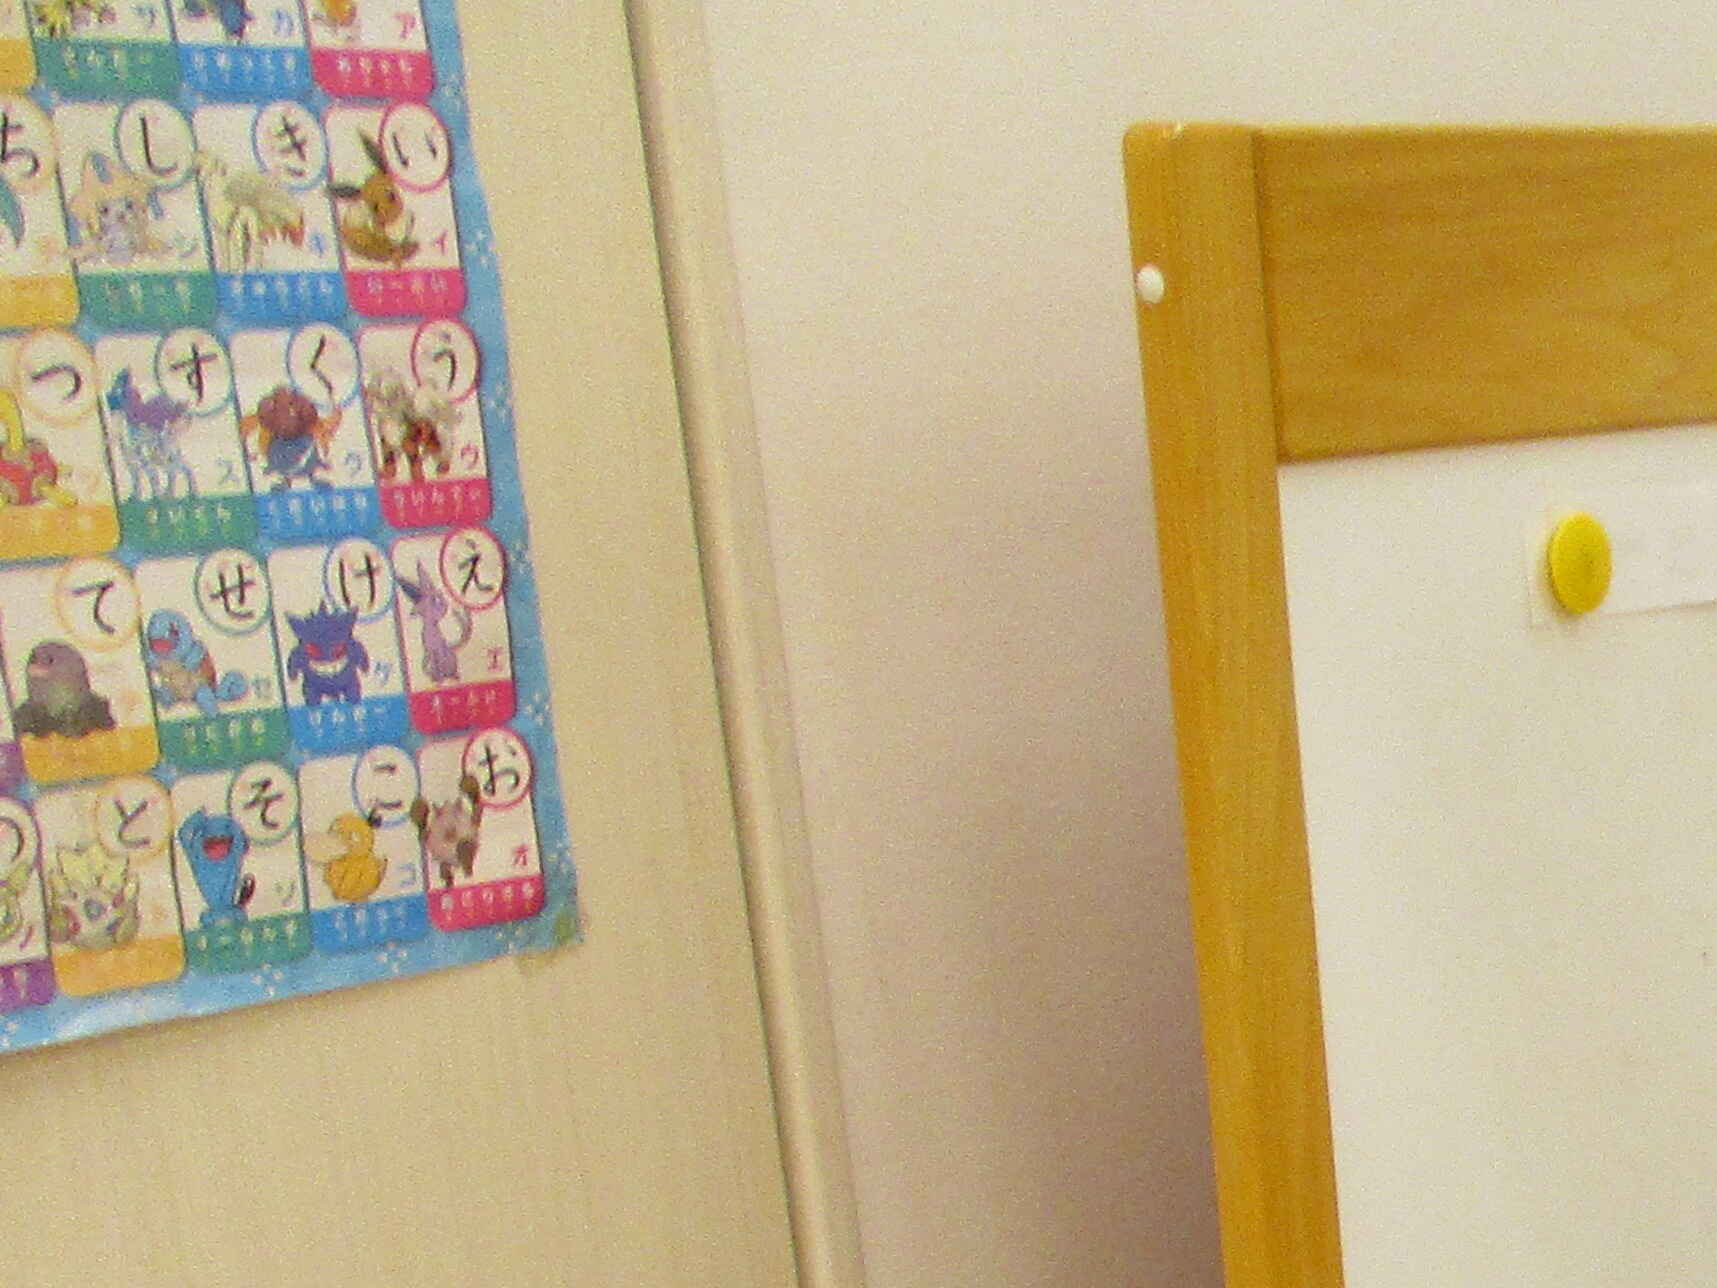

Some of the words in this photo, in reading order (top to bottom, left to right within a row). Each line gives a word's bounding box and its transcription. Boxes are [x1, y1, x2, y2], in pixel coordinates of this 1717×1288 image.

[139, 116, 178, 176] し
[272, 114, 308, 178] き
[391, 131, 437, 169] い
[31, 363, 83, 401] つ
[169, 342, 219, 403] す
[310, 335, 334, 398] く
[432, 332, 458, 393] う
[208, 563, 258, 619] せ
[338, 553, 383, 611] け
[457, 538, 496, 597] え
[71, 580, 115, 635] て
[373, 764, 403, 811] こ
[478, 743, 522, 797] お
[113, 800, 151, 846] と
[242, 778, 285, 830] そ
